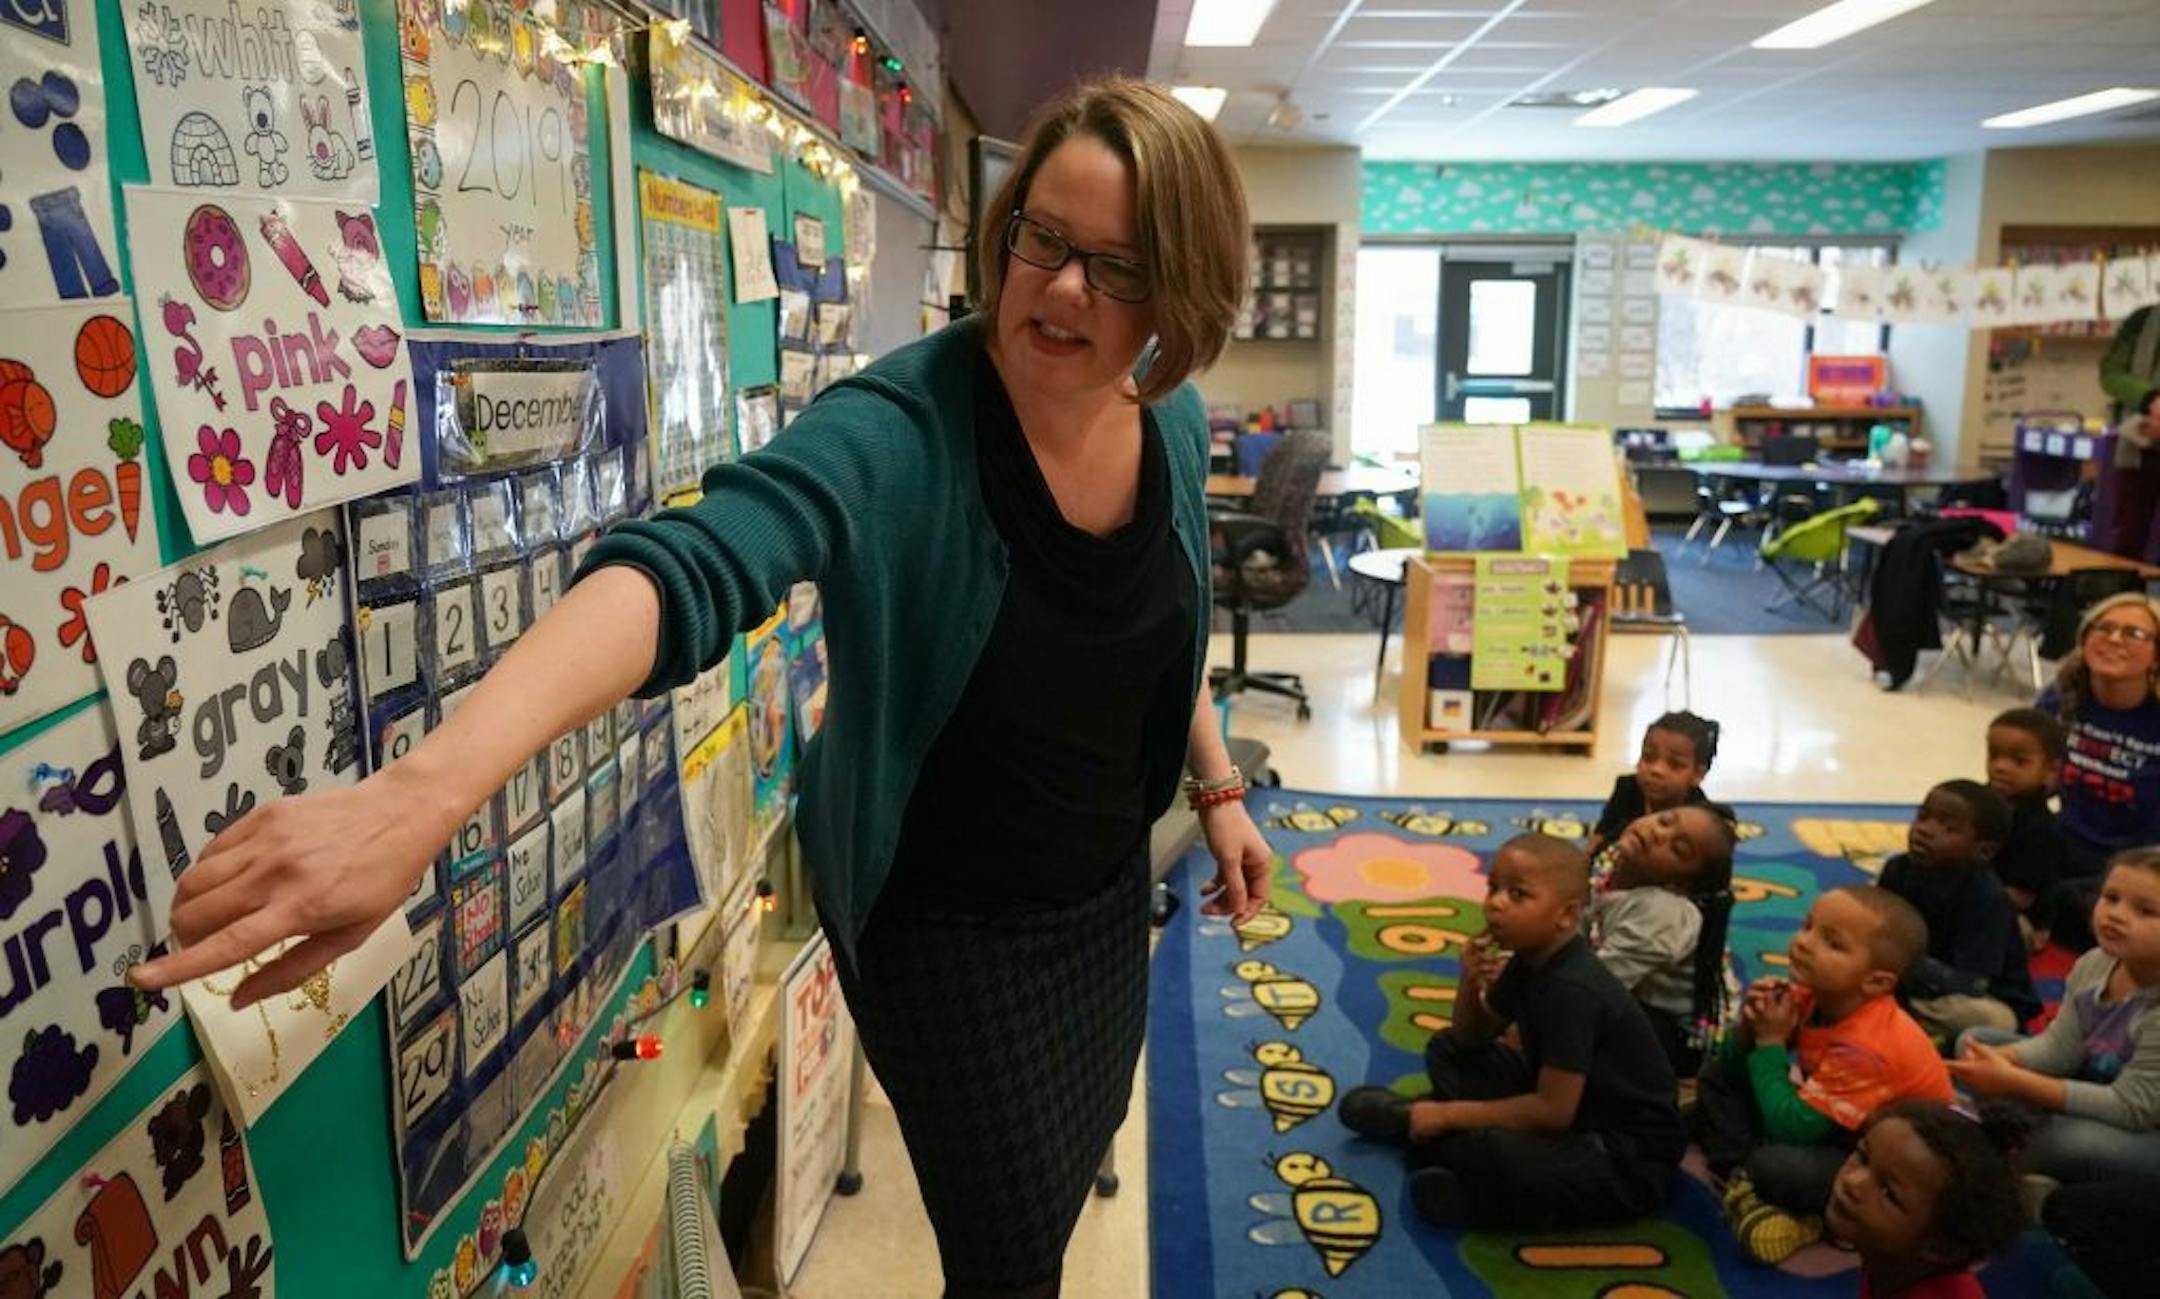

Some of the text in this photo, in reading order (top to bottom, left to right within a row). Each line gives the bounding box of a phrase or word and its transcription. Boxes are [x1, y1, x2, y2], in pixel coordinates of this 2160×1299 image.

[451, 79, 566, 214] 2019
[231, 312, 351, 411] pink
[477, 388, 577, 431] Decemb
[446, 603, 464, 655] 2
[493, 586, 509, 632] 3
[384, 622, 391, 676] 1
[193, 649, 308, 778] gray
[555, 738, 573, 785] 18
[401, 1031, 447, 1113] 29
[1276, 1080, 1321, 1100] S
[1311, 1200, 1364, 1225] R
